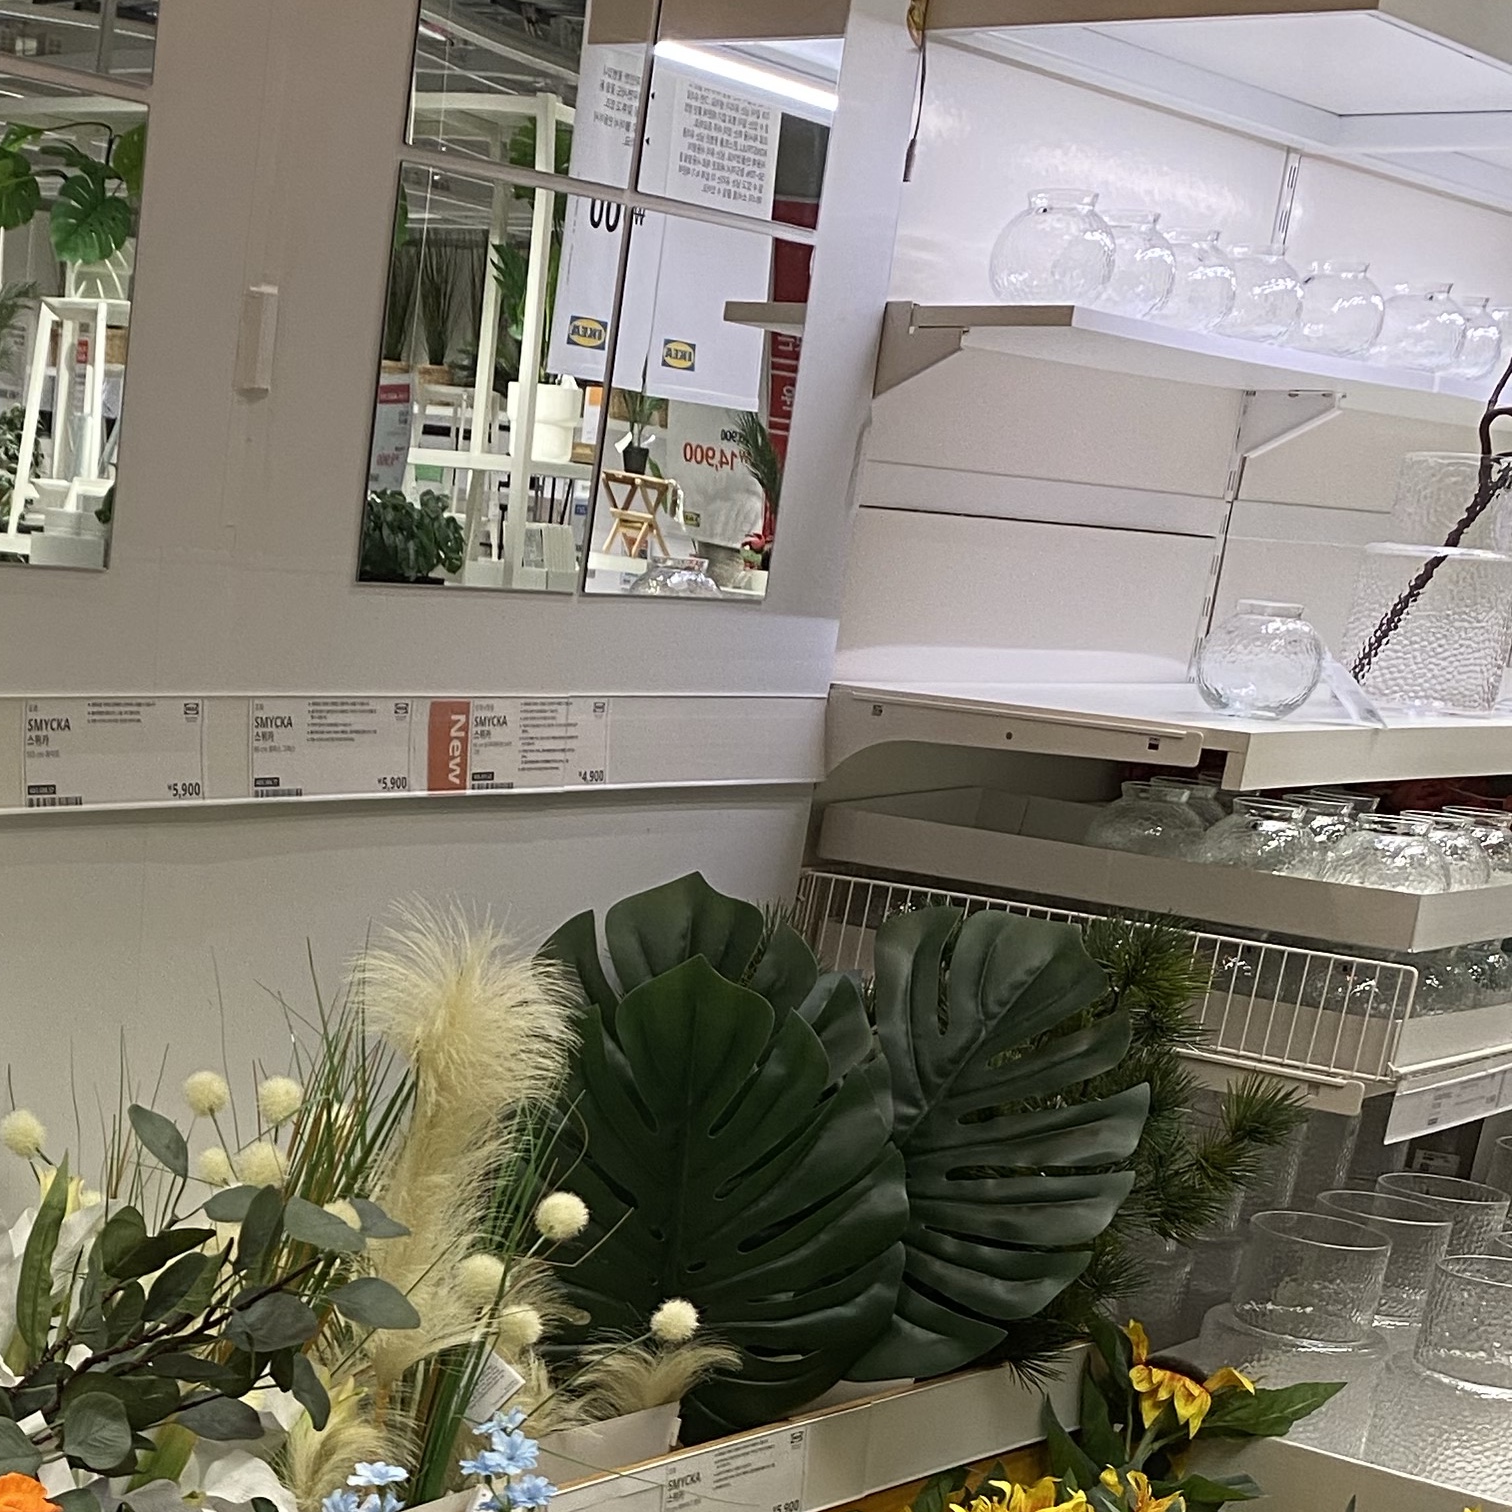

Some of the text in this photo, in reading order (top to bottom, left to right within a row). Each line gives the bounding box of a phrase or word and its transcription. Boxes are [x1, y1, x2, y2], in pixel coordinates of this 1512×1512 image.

[27, 718, 71, 732] SMYCKA
[254, 716, 293, 729] SMYCKA
[474, 715, 508, 728] SMYCKA
[448, 714, 466, 785] New
[668, 1472, 701, 1491] SMYCKA
